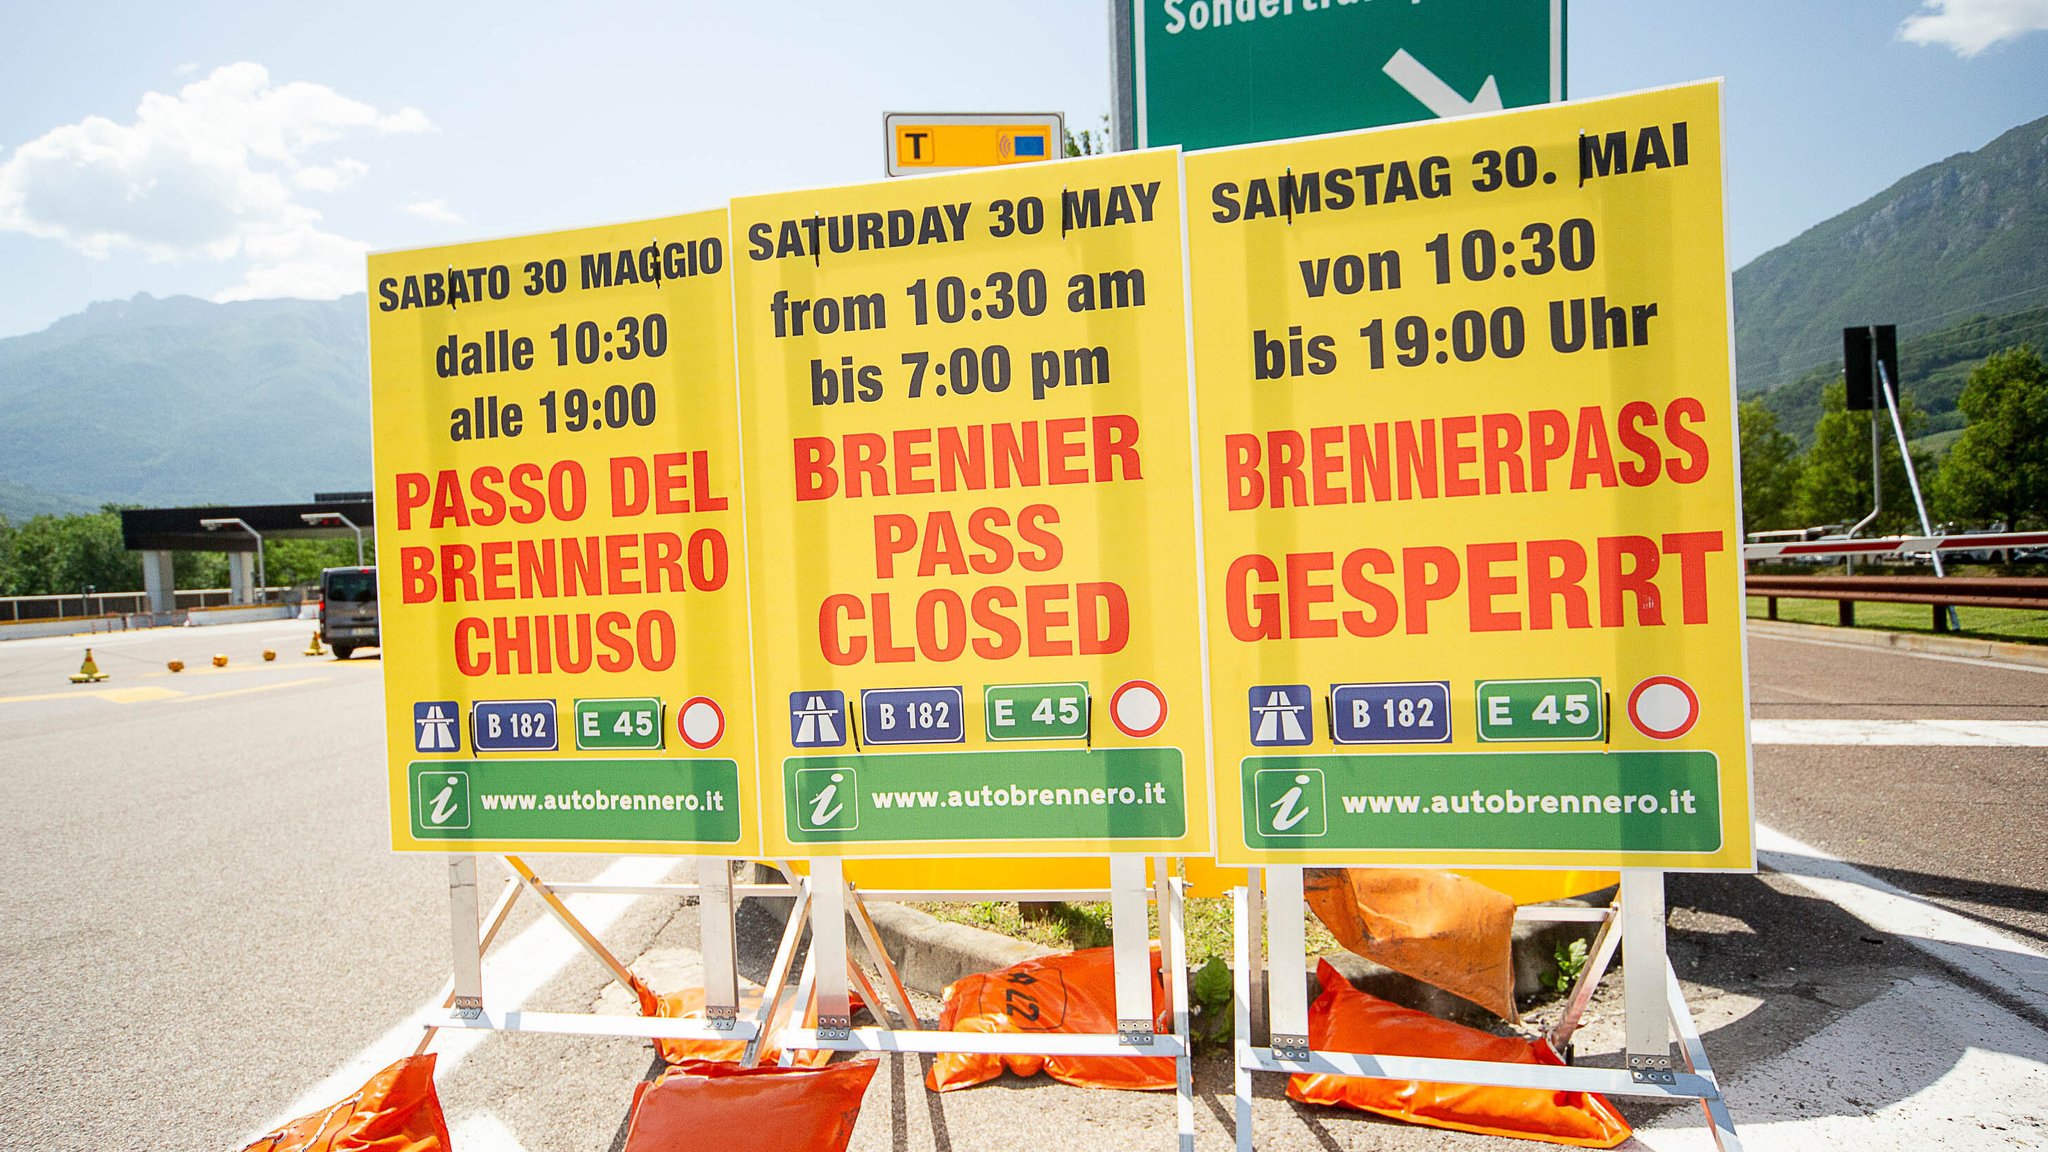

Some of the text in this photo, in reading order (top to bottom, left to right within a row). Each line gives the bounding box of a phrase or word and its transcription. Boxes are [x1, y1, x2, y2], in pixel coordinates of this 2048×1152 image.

[905, 133, 928, 159] T
[1212, 122, 1689, 224] SAMSTAG 30. MAI
[748, 181, 1161, 262] SATURDAY 30 MAY
[379, 237, 723, 312] SABATO 30 MAGGIO
[1299, 218, 1595, 297] von 10:30
[771, 269, 1145, 337] from 10:30 am
[436, 314, 667, 378] dalle 10:30
[1254, 296, 1657, 380] bis 19:00 Uhr
[811, 345, 1109, 405] bis 7:00 pm
[451, 383, 655, 441] alle 19:00
[794, 415, 1142, 501] BRENNER
[1225, 398, 1709, 511] BRENNERPASS
[396, 450, 728, 530] PASSO DEL
[400, 528, 729, 604] BRENNERO
[874, 504, 1062, 578] PASS
[1226, 531, 1724, 642] GESPERRT
[454, 610, 676, 677] CHIUSO
[819, 582, 1130, 666] CLOSED
[489, 713, 545, 737] B 182
[583, 711, 652, 736] E 45
[880, 702, 949, 729] B 182
[995, 698, 1079, 725] E 45
[1353, 699, 1433, 727] B 182
[1489, 695, 1589, 725] E 45
[481, 790, 723, 810] www.autobrennero.it
[872, 783, 1165, 808] www.autobrennero.it
[1343, 790, 1696, 813] www.autobrennero.it
